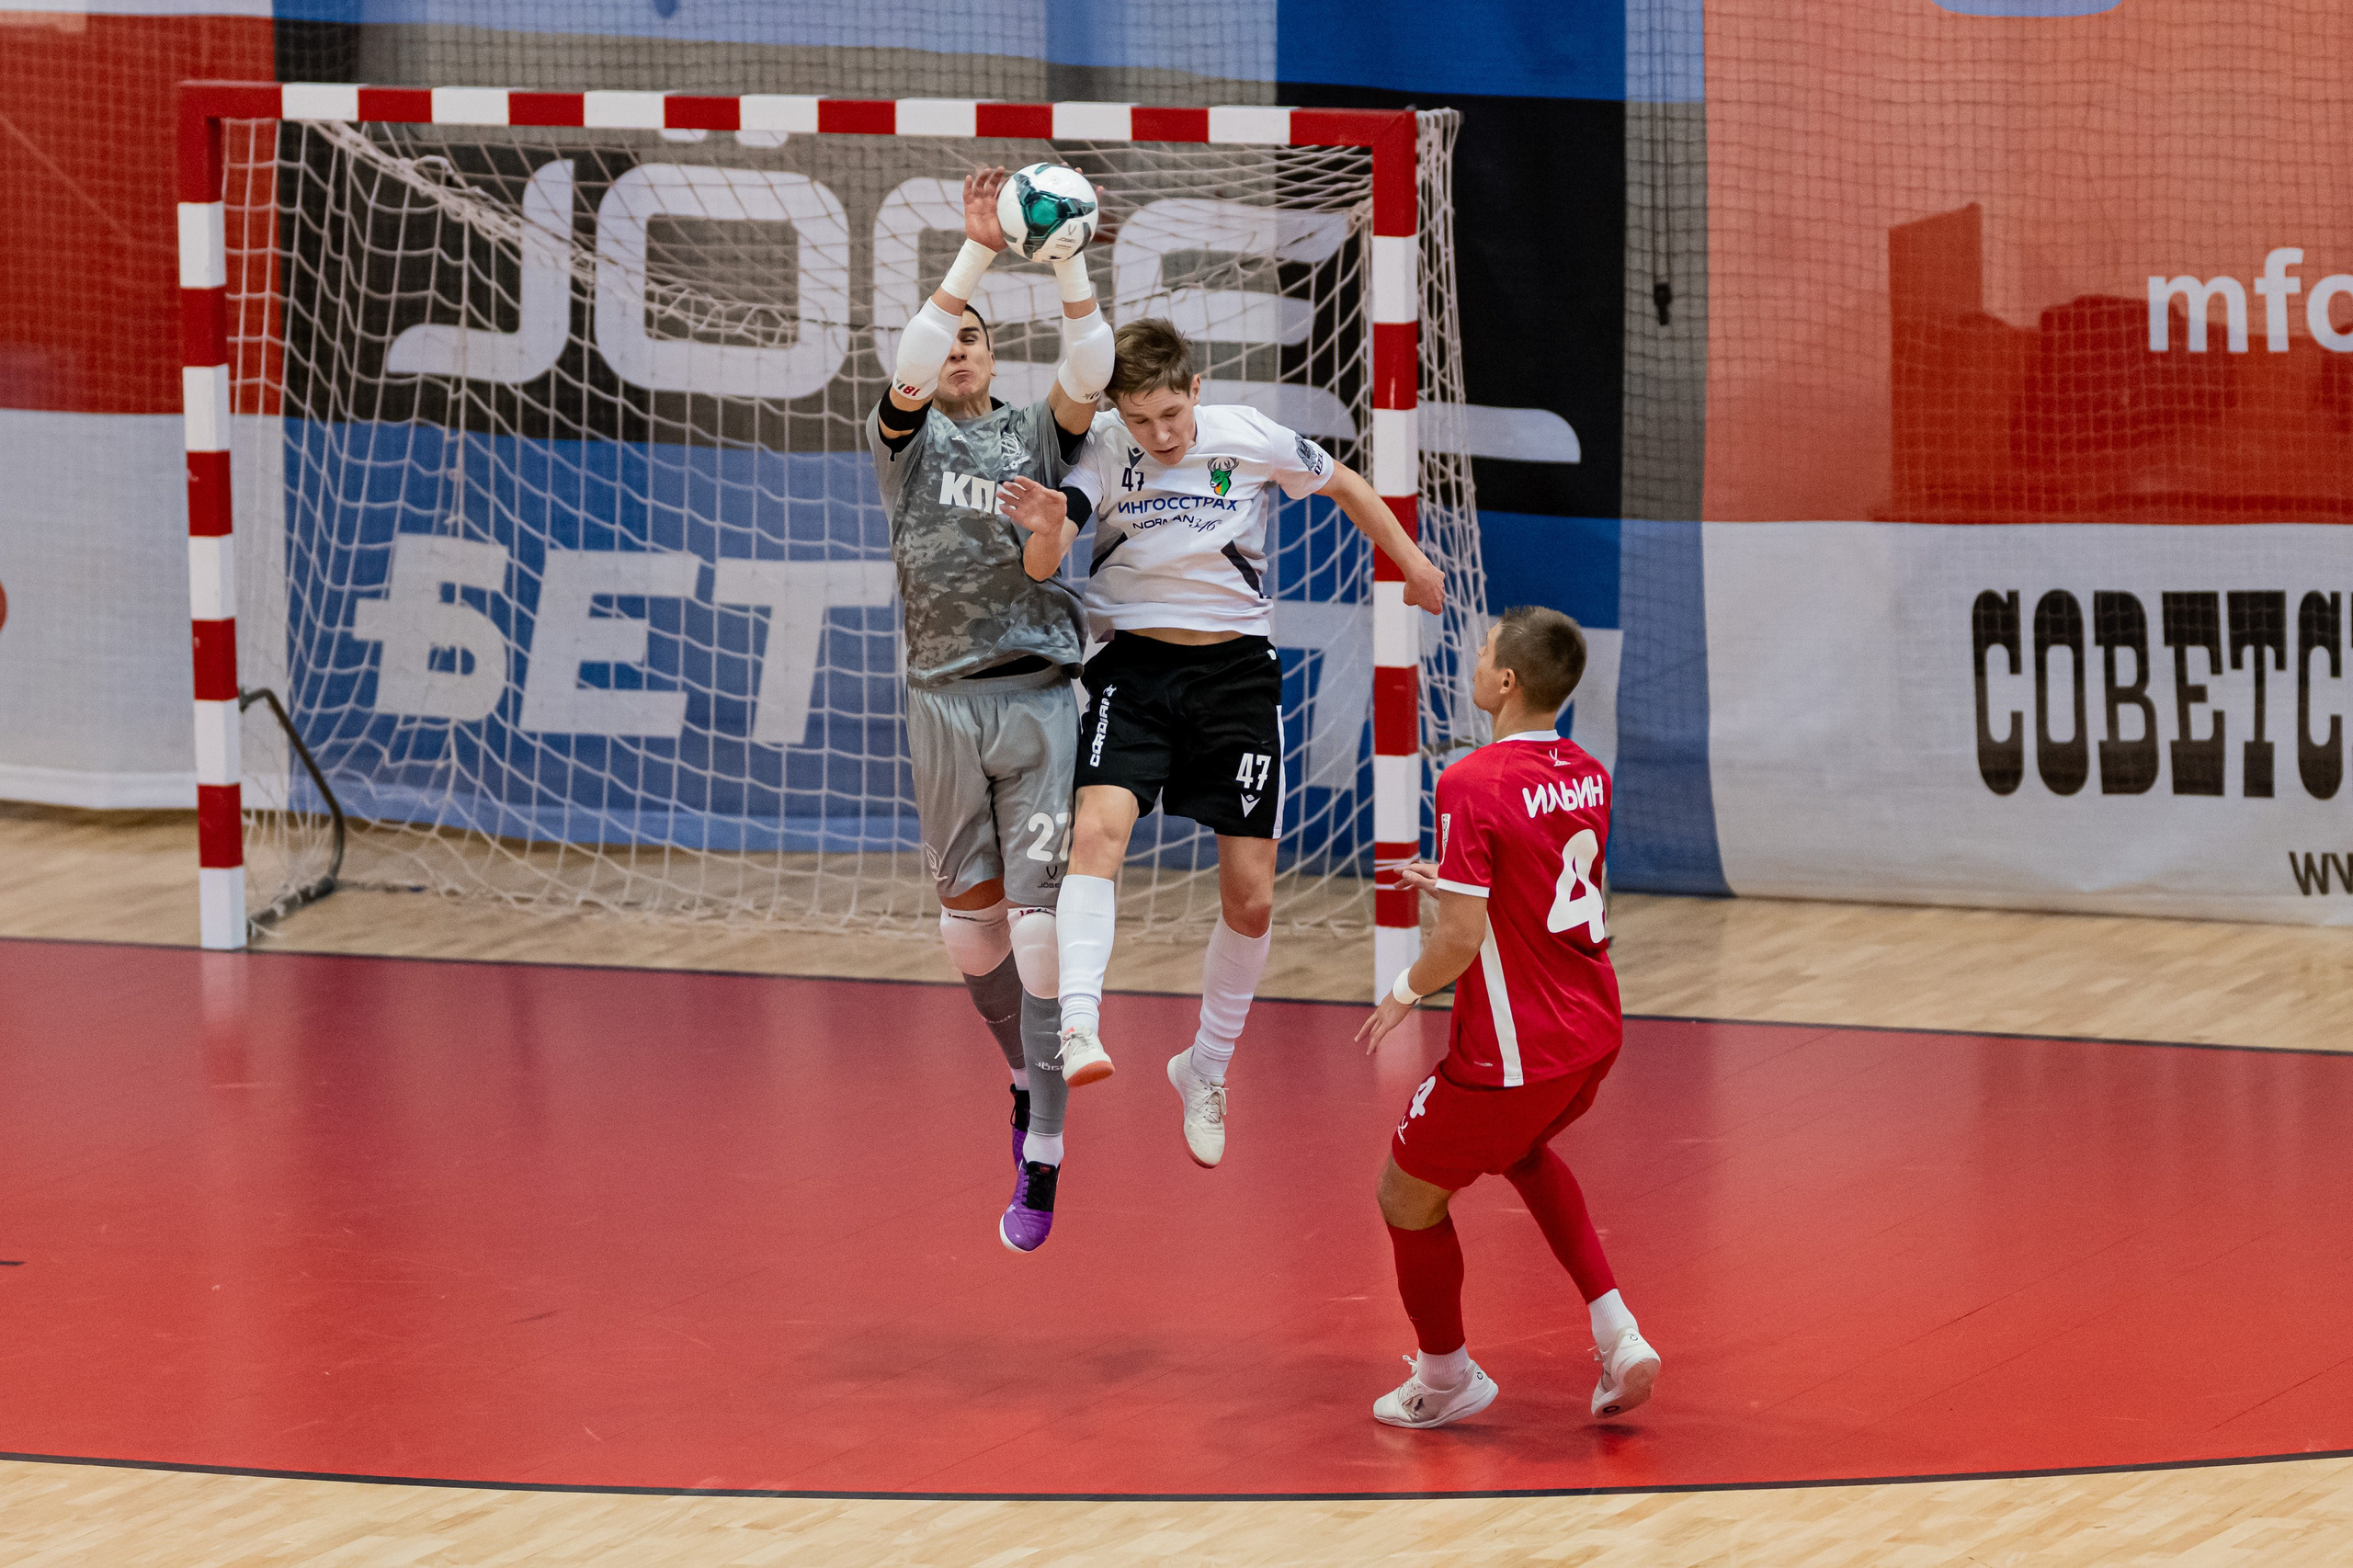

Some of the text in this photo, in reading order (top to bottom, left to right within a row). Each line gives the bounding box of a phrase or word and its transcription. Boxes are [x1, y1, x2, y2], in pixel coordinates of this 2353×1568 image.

[939, 472, 1027, 515] КП
[1121, 467, 1144, 492] 47
[1118, 496, 1238, 514] ИНГОССТРАХ
[1972, 589, 2353, 800] СОВЕТС
[1235, 753, 1271, 791] 47
[1522, 774, 1604, 818] ИЛЬИН
[1027, 812, 1071, 862] 27
[1546, 828, 1605, 944] 4
[1035, 1062, 1064, 1072] JÖG
[1409, 1075, 1436, 1119] 4
